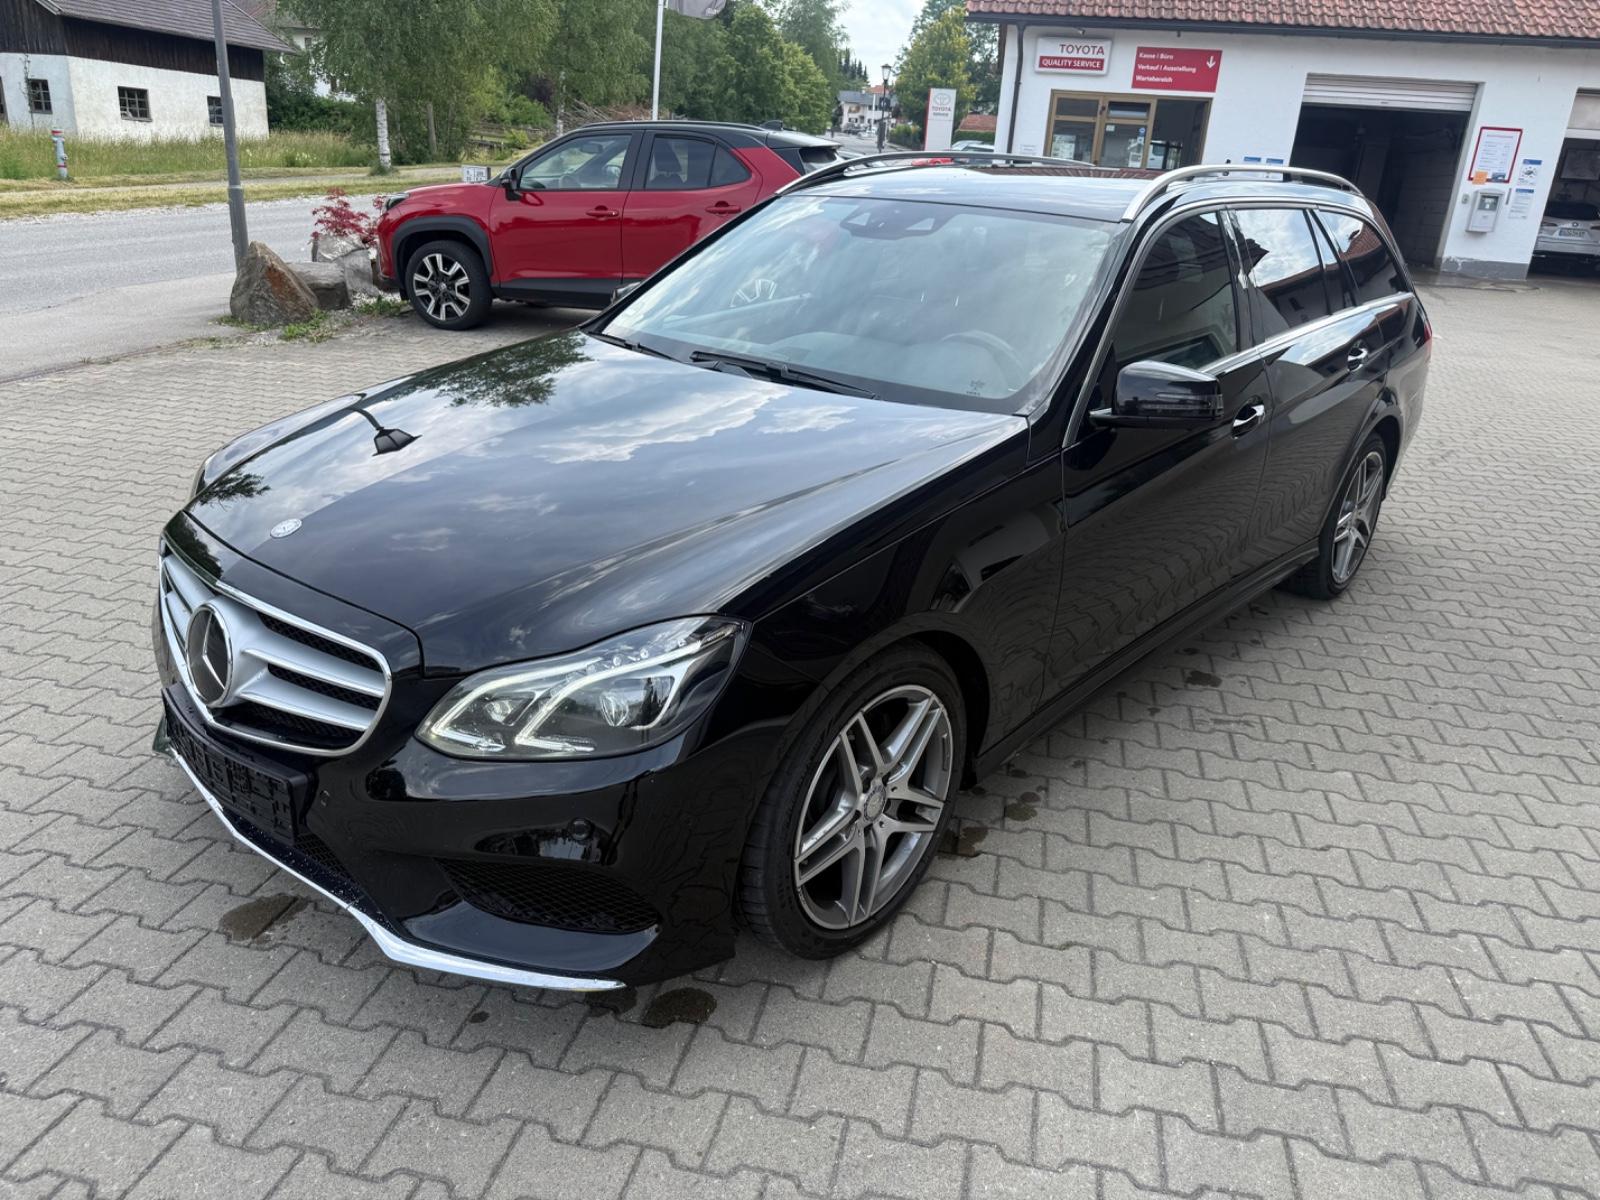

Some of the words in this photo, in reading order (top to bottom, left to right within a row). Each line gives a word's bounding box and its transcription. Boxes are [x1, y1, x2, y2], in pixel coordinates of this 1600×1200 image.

[1059, 44, 1105, 55] TOYOTA
[1042, 58, 1071, 67] QUALITY
[1073, 59, 1102, 68] SERVICE
[1163, 65, 1197, 74] Ausstellung
[1136, 75, 1173, 83] Wartebereich
